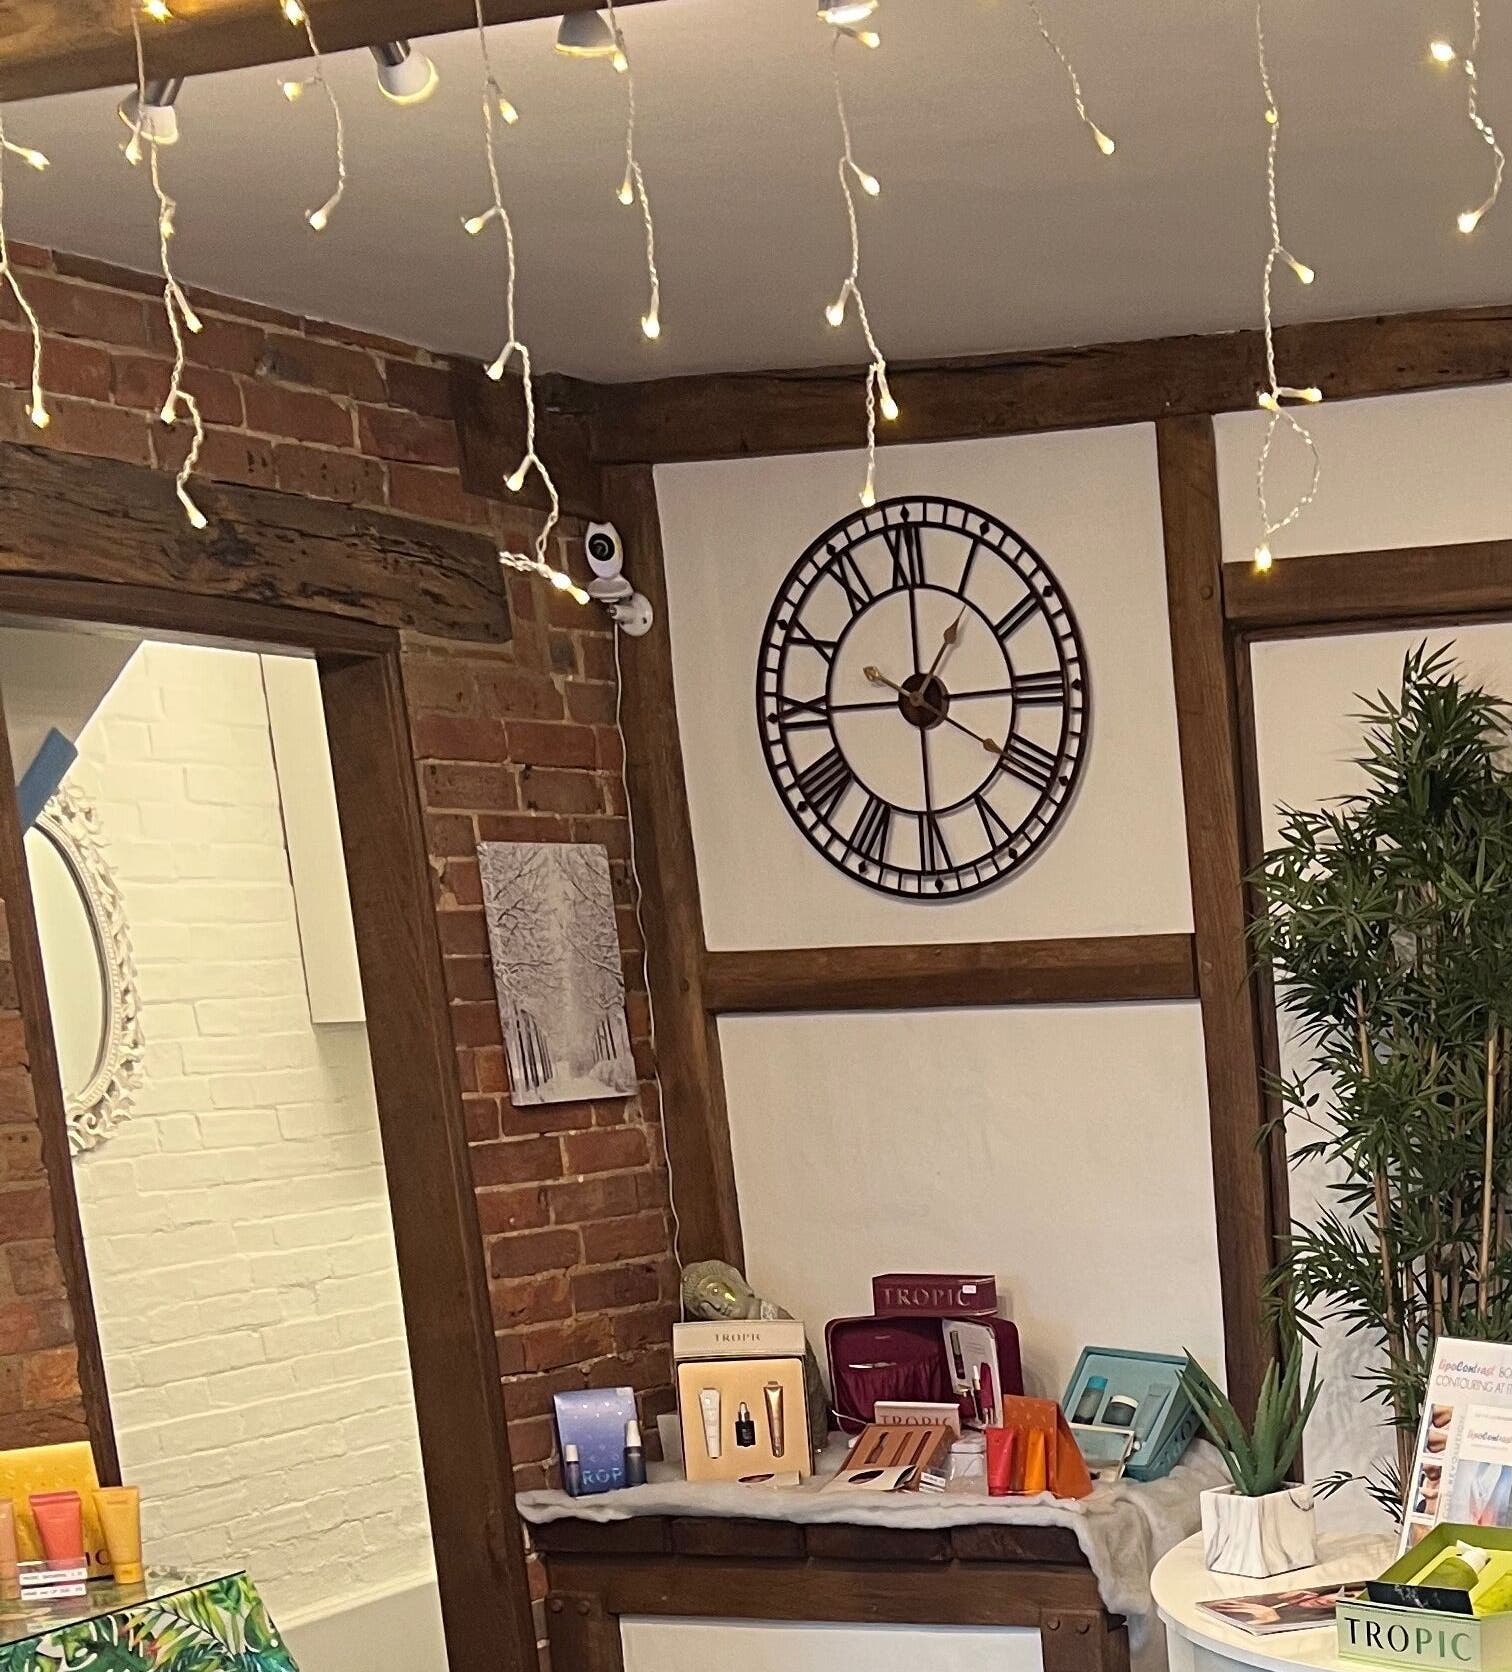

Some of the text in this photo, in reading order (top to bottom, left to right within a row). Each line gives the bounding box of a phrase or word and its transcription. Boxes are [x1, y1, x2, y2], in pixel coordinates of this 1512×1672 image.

[883, 525, 925, 589] XII
[881, 1288, 971, 1306] TROPIC
[1435, 1375, 1494, 1392] CONTOURING
[1495, 1382, 1506, 1393] AT
[1344, 1617, 1473, 1661] TROPIC
